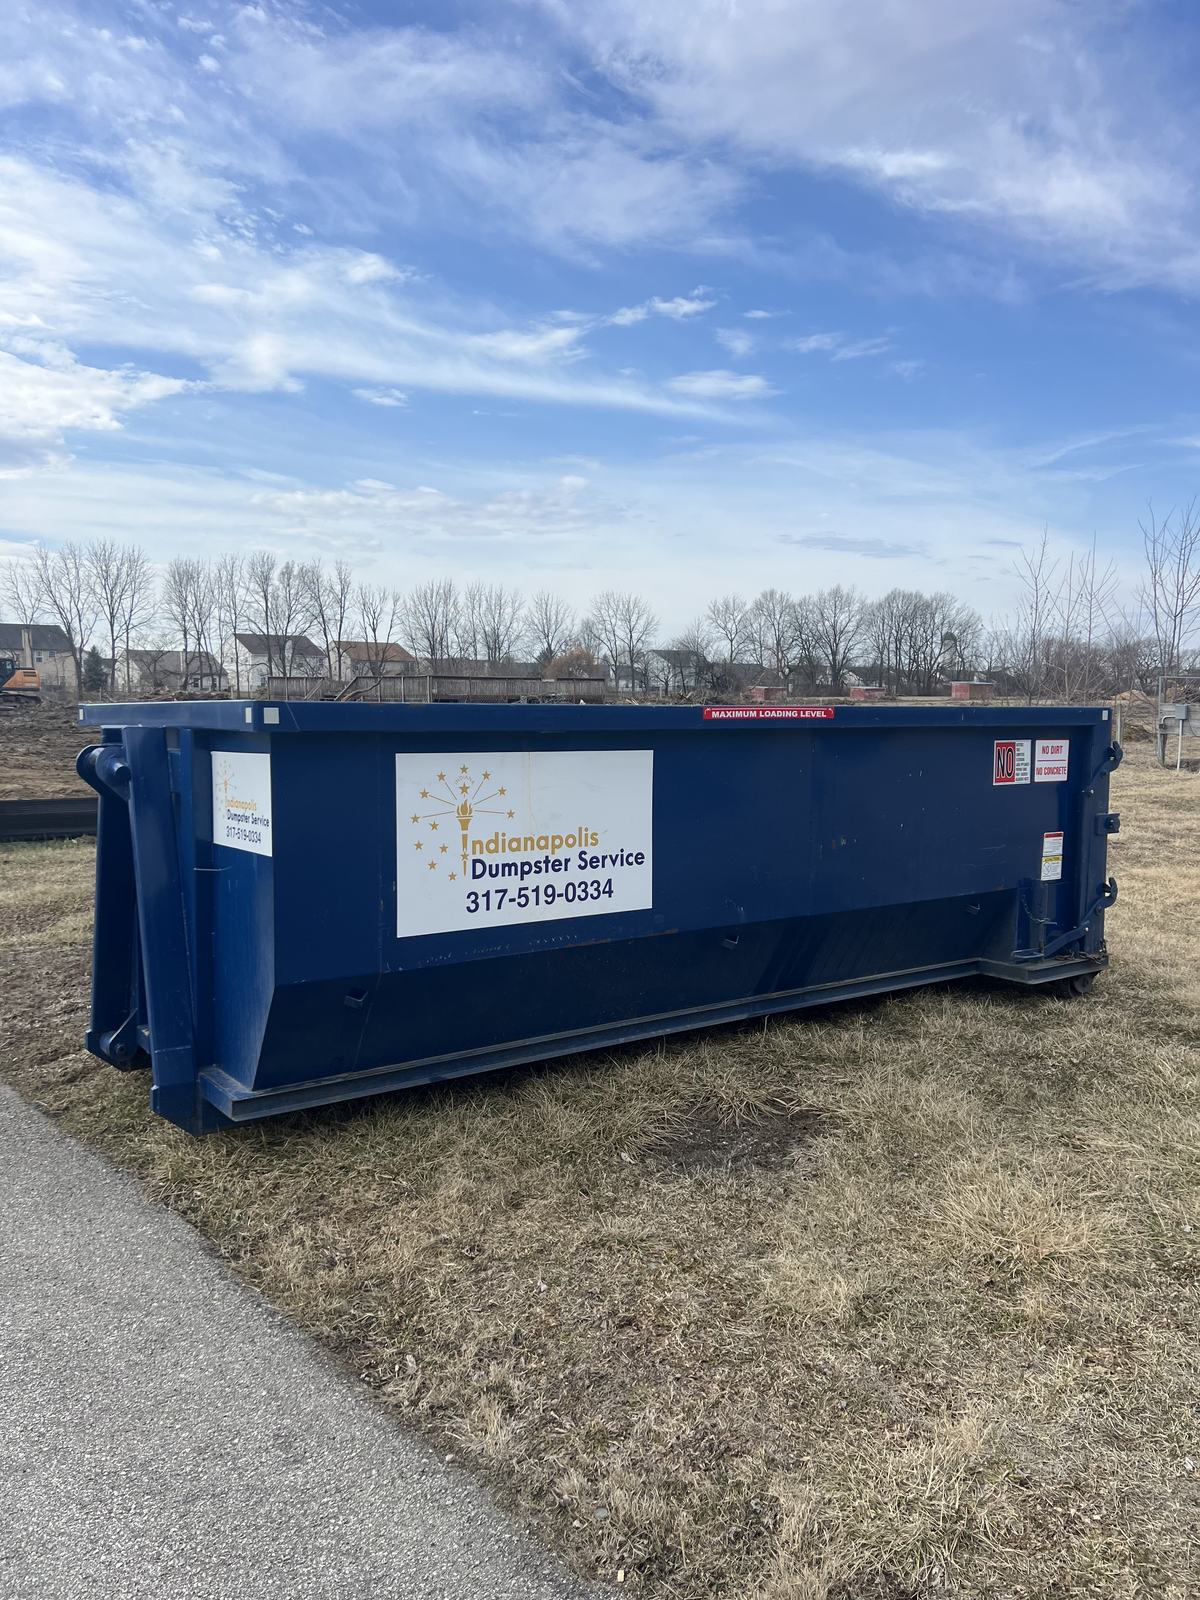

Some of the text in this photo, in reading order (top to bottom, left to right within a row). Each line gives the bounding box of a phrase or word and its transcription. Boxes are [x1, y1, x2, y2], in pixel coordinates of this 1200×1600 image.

[759, 710, 798, 718] LOADING
[800, 710, 827, 718] LEVEL
[1042, 746, 1063, 754] NO DIRT
[996, 747, 1014, 778] NO
[1036, 767, 1066, 775] NO CONCRETE
[227, 809, 270, 827] Dumpster Service
[226, 825, 262, 843] 317-519-0334
[471, 848, 646, 881] Dumpster Service
[466, 878, 614, 914] 317-519-0334
